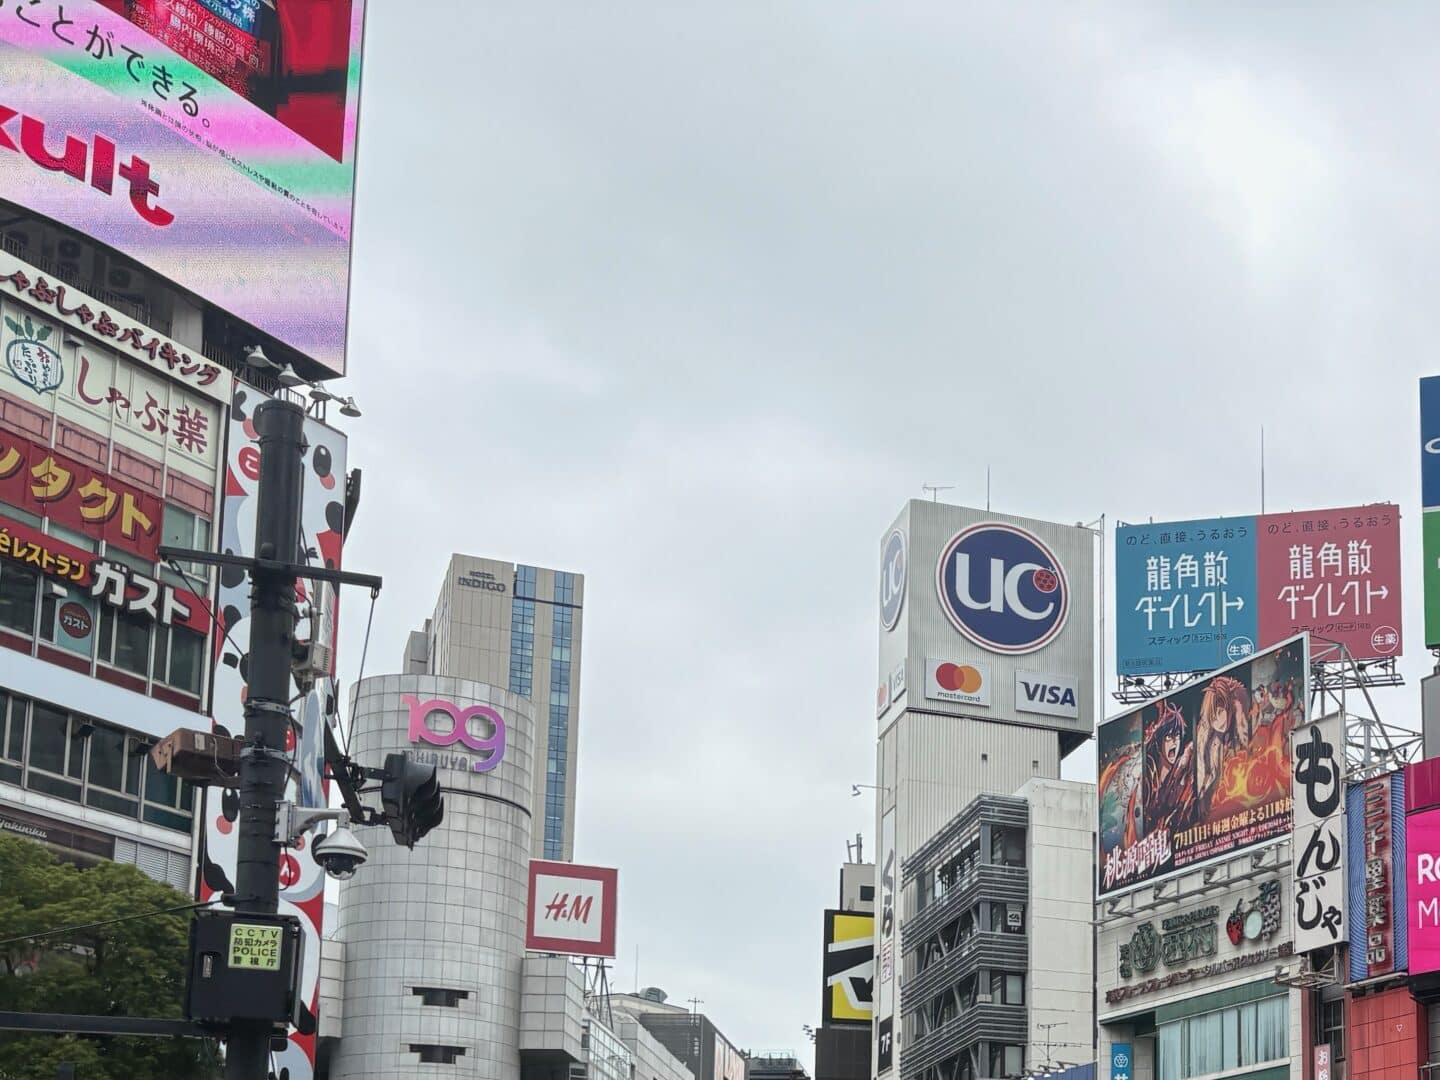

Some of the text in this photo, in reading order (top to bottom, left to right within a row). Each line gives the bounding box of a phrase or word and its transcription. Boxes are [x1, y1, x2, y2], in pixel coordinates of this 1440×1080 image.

[0, 270, 221, 384] ゃぶしゃぶバイキング
[78, 356, 208, 455] しゃぶ葉
[1126, 526, 1248, 546] のど、直接、うるおう
[1268, 515, 1392, 534] のど、直接、うるおう
[1147, 550, 1230, 592] 龍角散
[1289, 539, 1373, 580] 龍角散
[91, 560, 192, 625] ガスト
[458, 576, 506, 592] INDIGO
[1135, 590, 1245, 631] ダイレクト
[1278, 580, 1390, 620] ダイレクト
[1148, 634, 1190, 646] スティック
[1229, 645, 1252, 657] 生薬
[1373, 632, 1398, 646] 生薬
[937, 680, 1076, 707] mastercard VISA
[400, 694, 506, 772] 109
[1295, 724, 1342, 940] もんじゃ
[545, 891, 594, 924] H&M
[233, 937, 278, 948] 防犯カメラ
[234, 928, 279, 939] CCTV
[233, 946, 278, 957] POLICE
[880, 1032, 892, 1055] 7F
